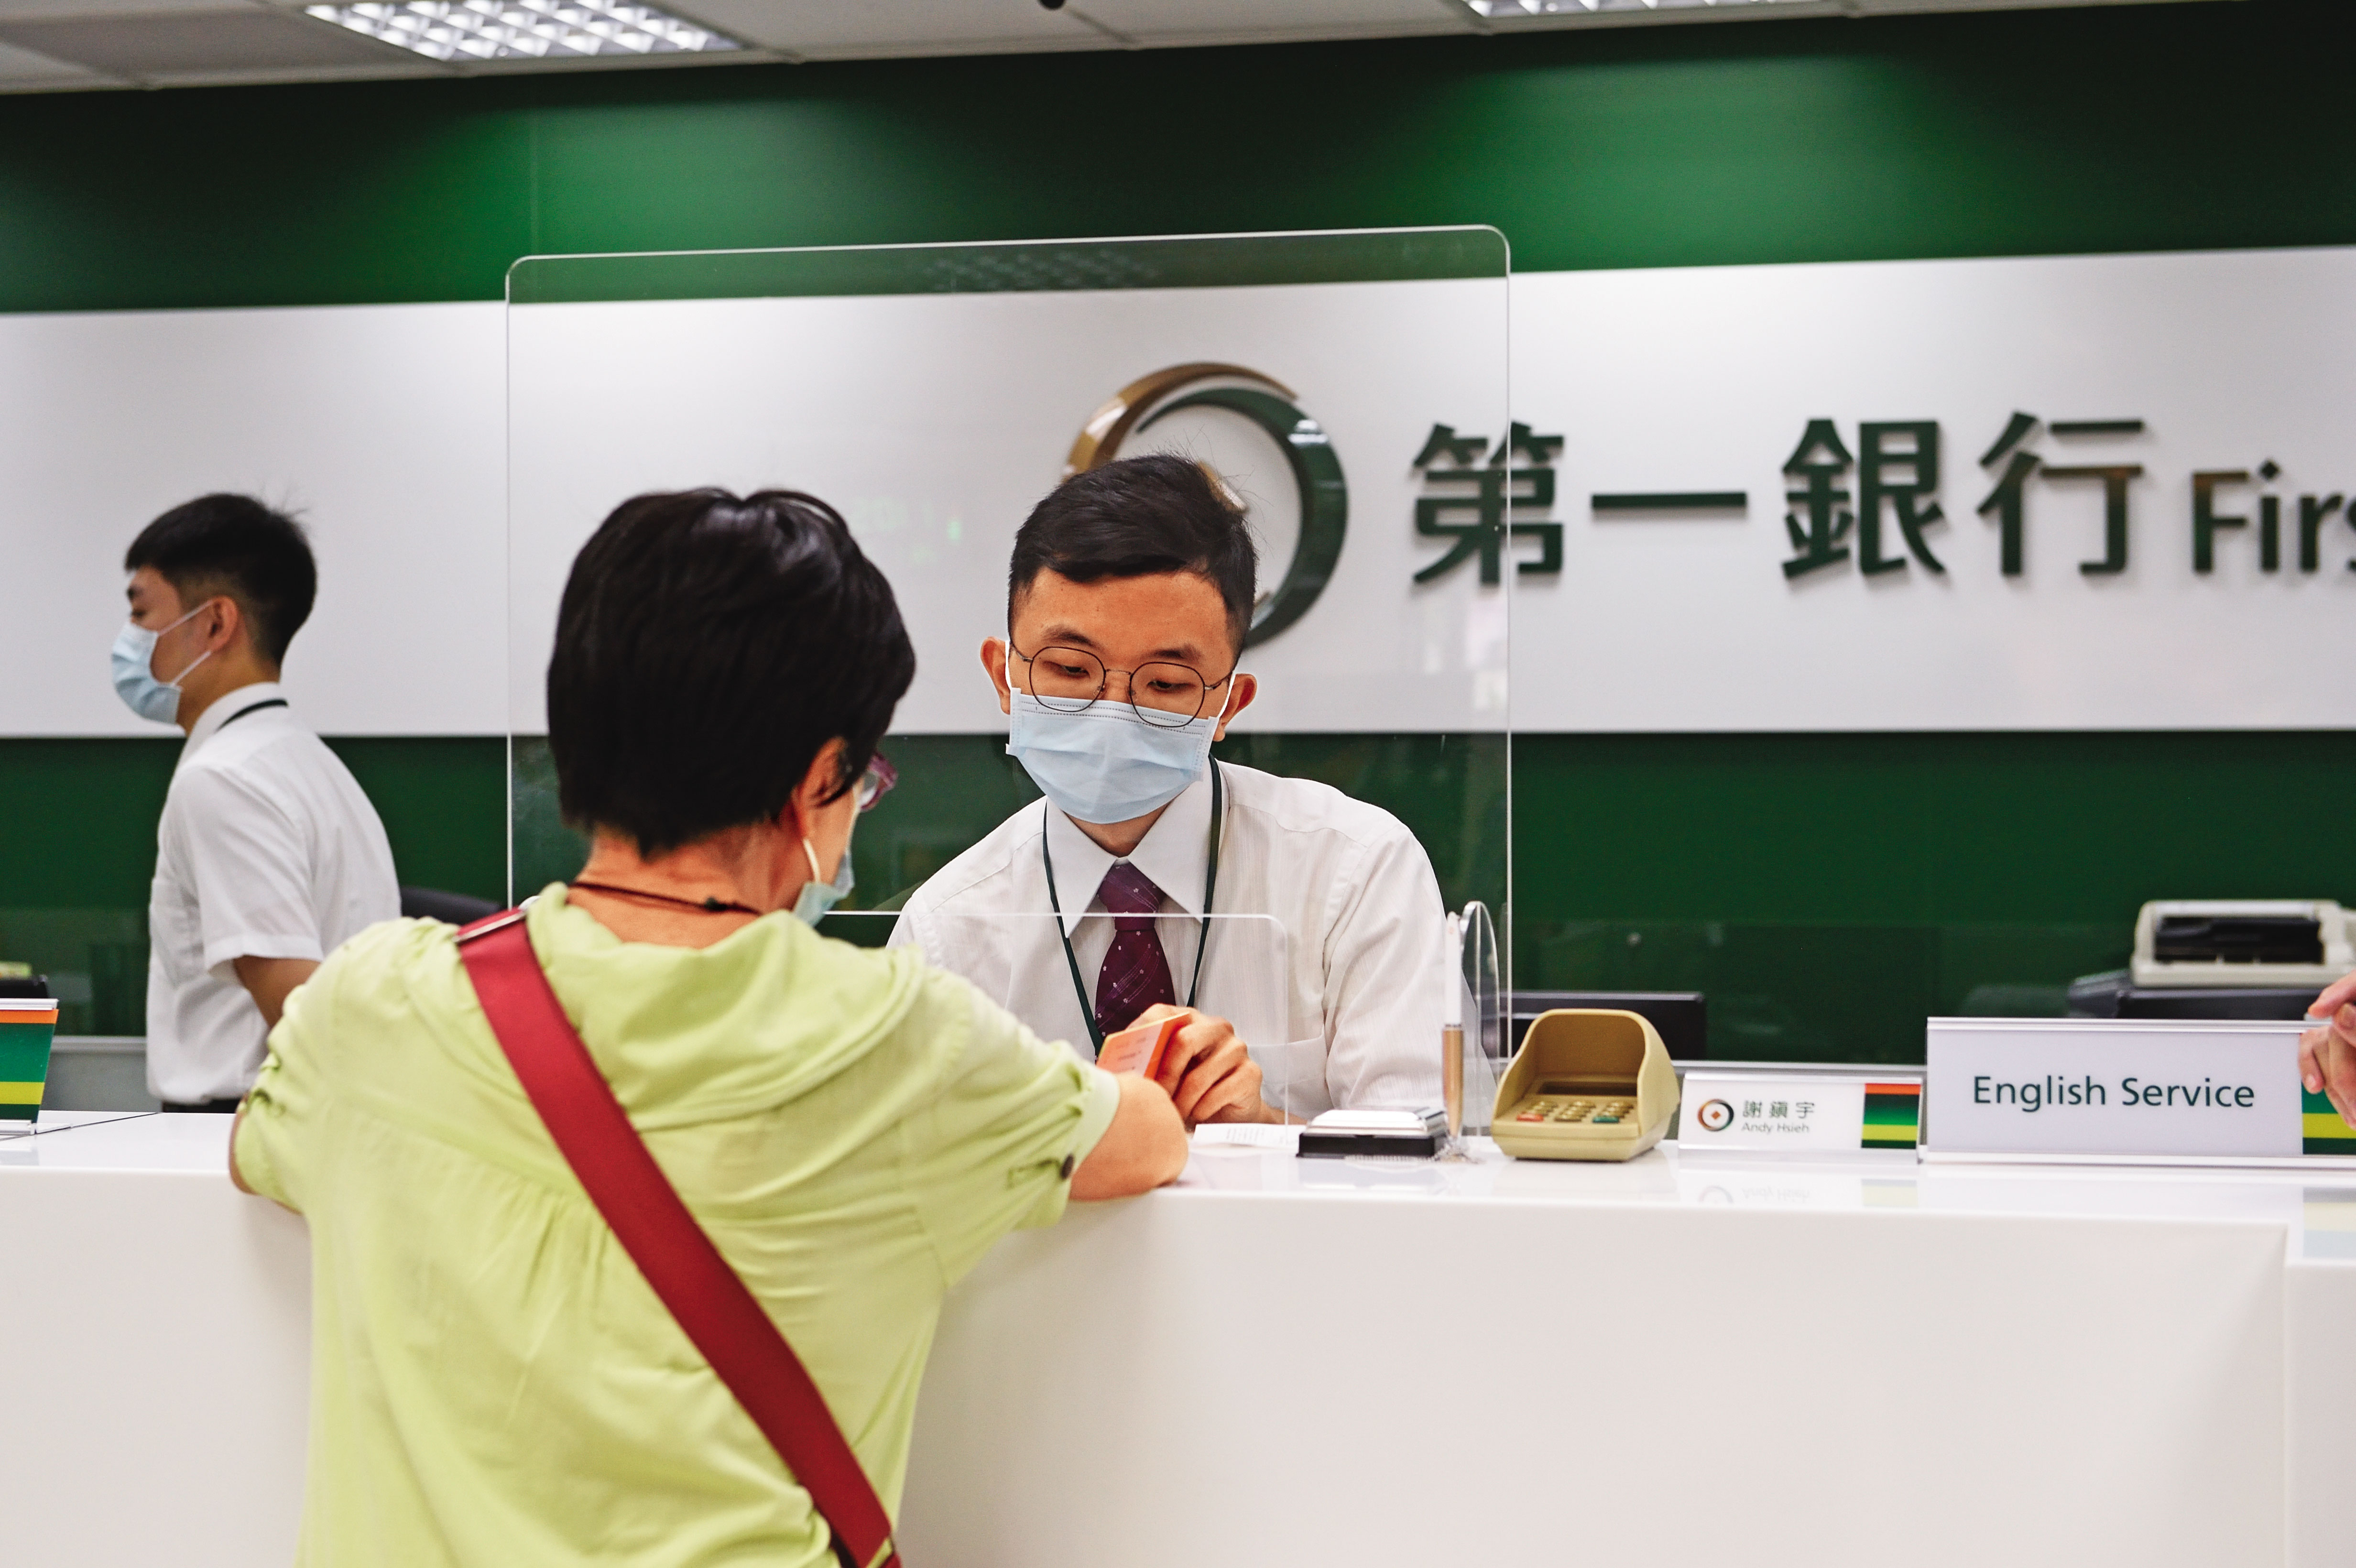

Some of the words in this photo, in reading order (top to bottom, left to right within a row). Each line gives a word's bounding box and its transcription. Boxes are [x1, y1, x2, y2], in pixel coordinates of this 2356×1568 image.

[1413, 412, 2144, 584] 第一銀行
[2191, 459, 2356, 574] Fir
[1974, 1075, 2105, 1113] English
[2121, 1078, 2255, 1108] Service
[1742, 1122, 1771, 1135] Andy
[1777, 1123, 1810, 1132] Hsieh
